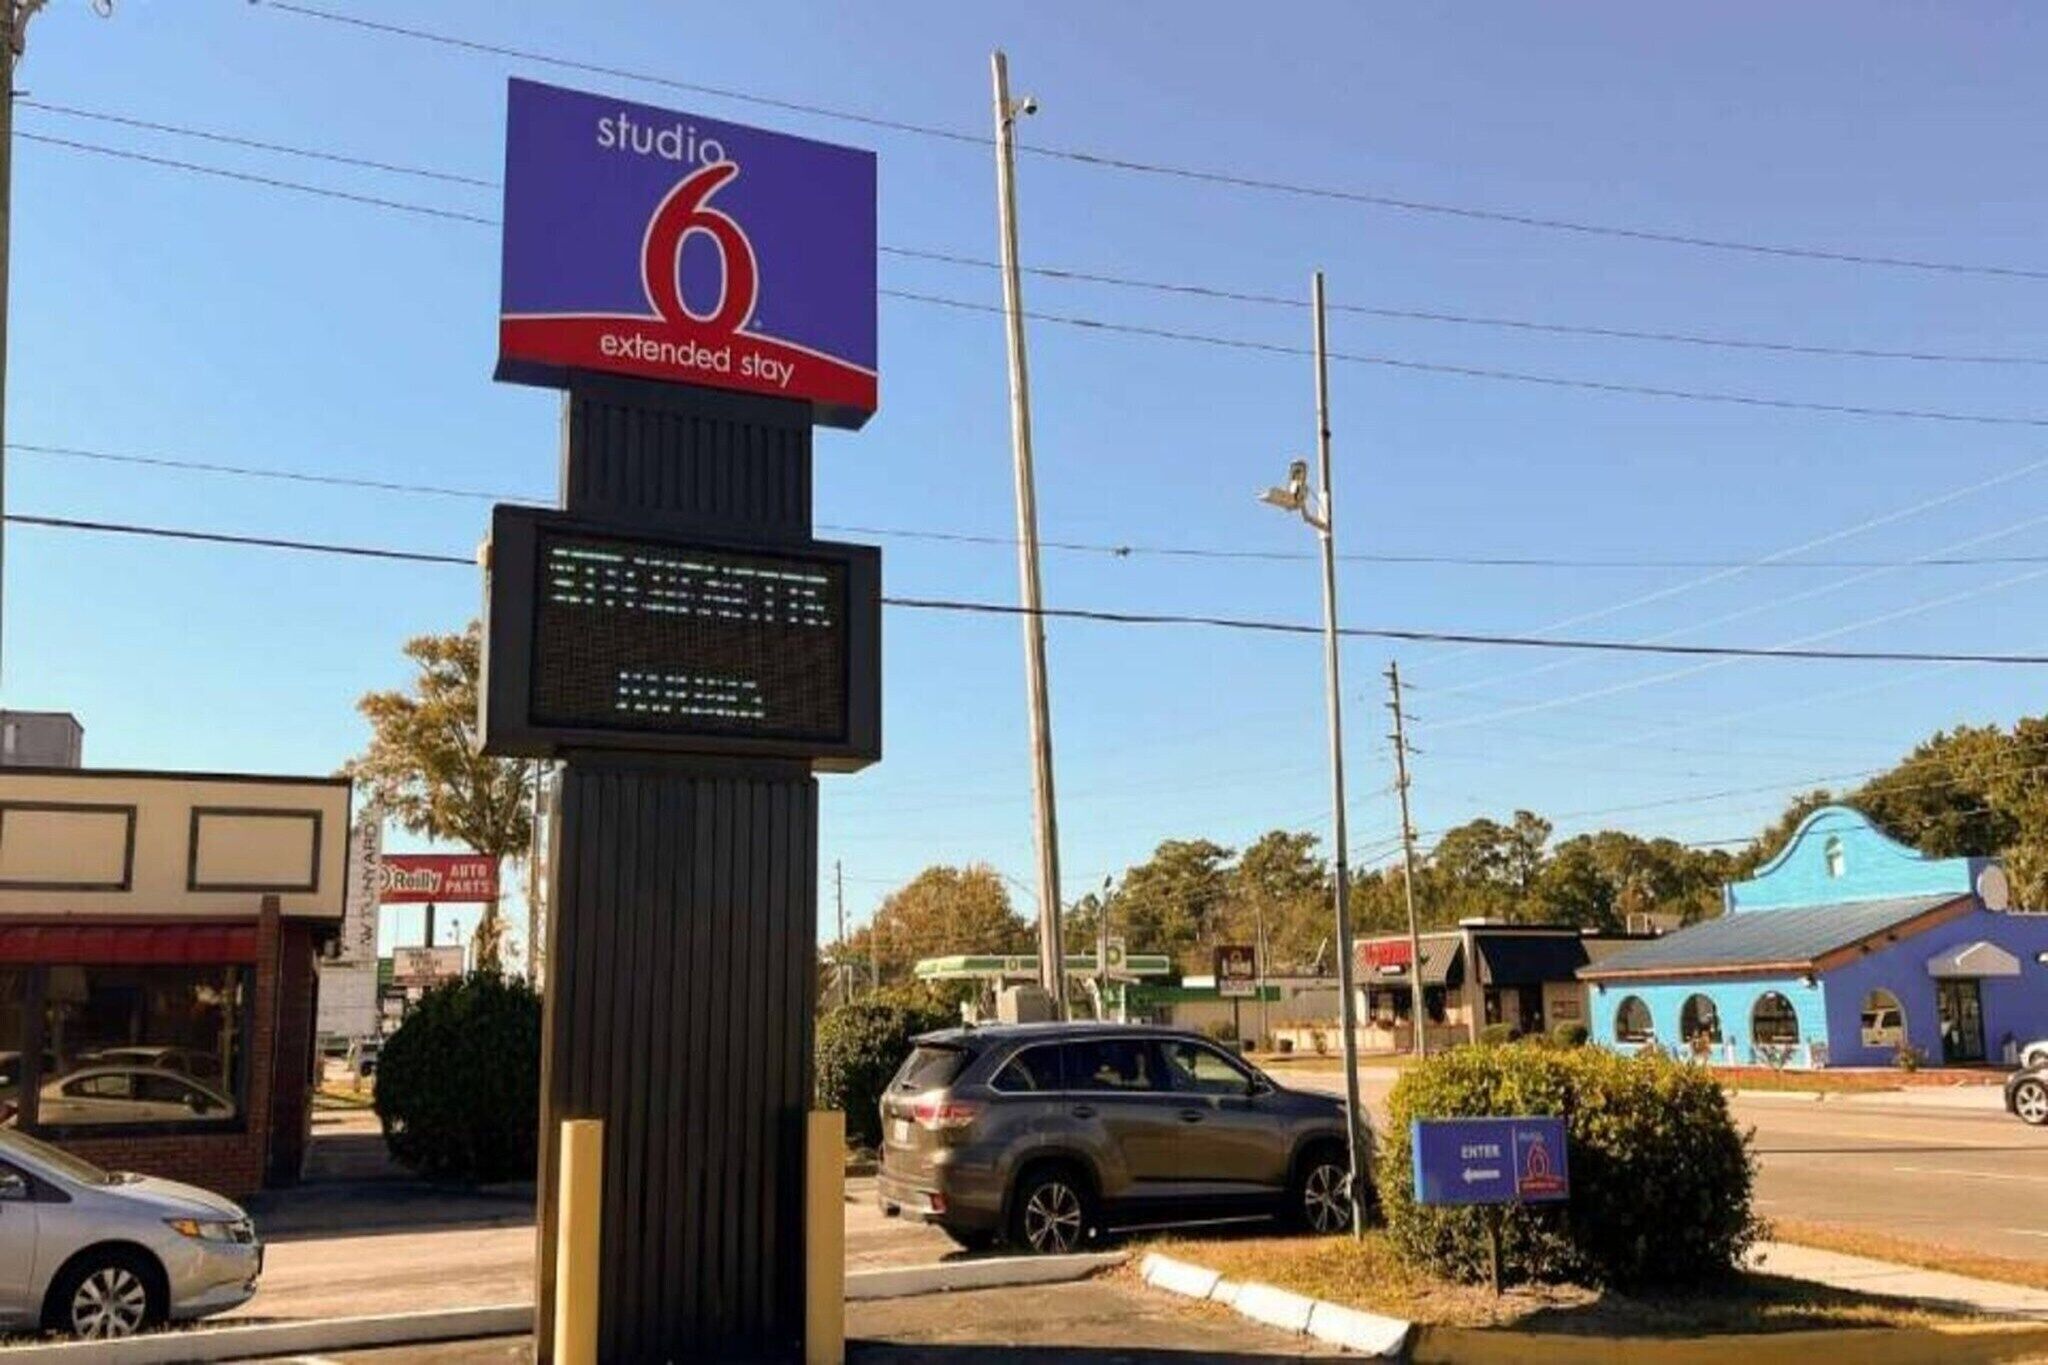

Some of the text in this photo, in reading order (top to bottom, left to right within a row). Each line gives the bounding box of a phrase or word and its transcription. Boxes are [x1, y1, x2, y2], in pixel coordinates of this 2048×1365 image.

[598, 112, 725, 164] studio
[641, 160, 759, 333] 6
[600, 332, 795, 388] extended stay
[445, 879, 491, 894] PARTS
[450, 863, 488, 878] AUTO
[1460, 1144, 1500, 1160] ENTER
